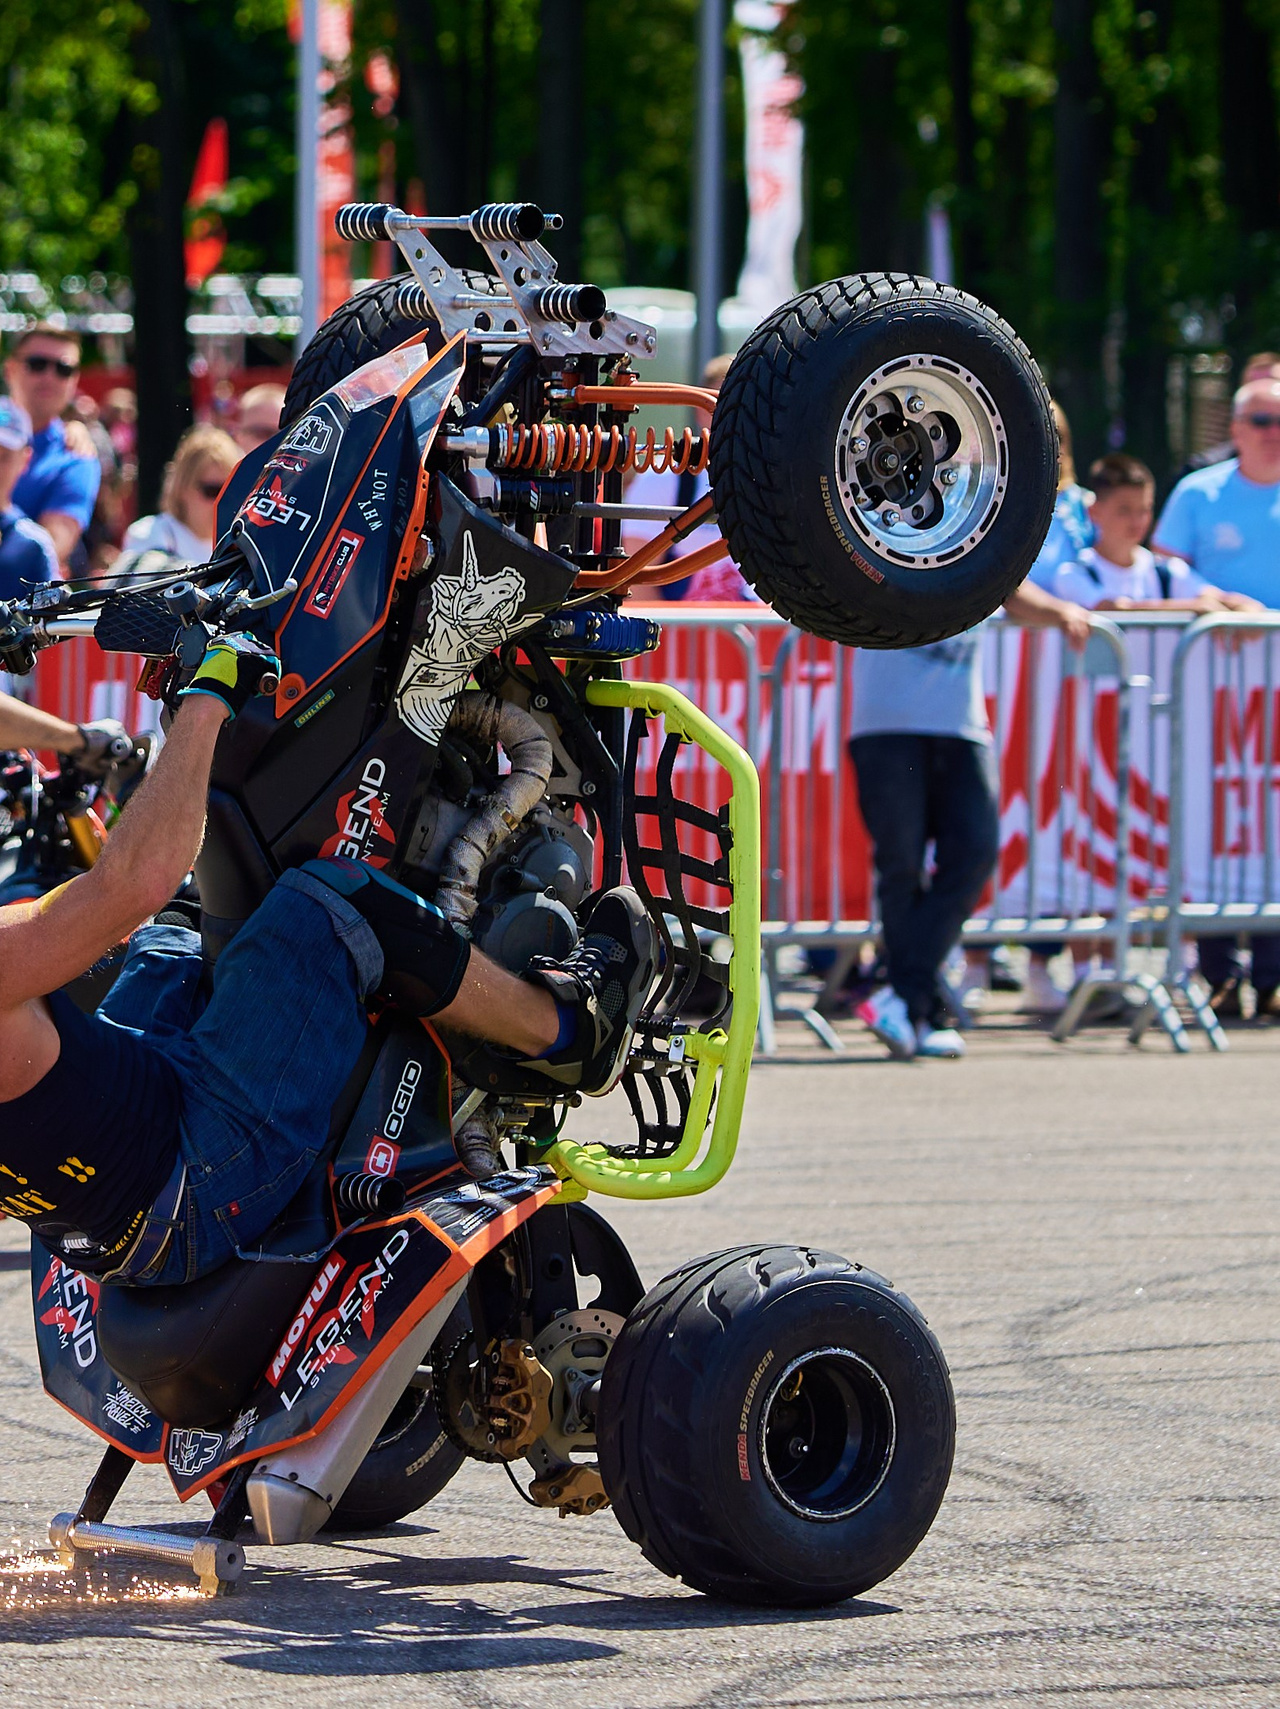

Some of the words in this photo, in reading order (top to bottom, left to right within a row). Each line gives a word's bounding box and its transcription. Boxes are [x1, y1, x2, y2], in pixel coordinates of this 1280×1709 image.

[358, 499, 384, 532] WHY
[372, 469, 388, 501] NOT
[820, 475, 853, 553] SPEEDRACER
[849, 551, 885, 584] KENDA
[369, 792, 391, 837] TEAM
[384, 1060, 422, 1140] OGIO
[50, 1254, 61, 1294] UNT
[54, 1296, 69, 1349] TEAM
[272, 1262, 341, 1379] MOTUL
[280, 1229, 410, 1411] LEGEND
[310, 1325, 352, 1389] STUNT
[353, 1272, 394, 1322] TEAM
[739, 1349, 775, 1433] SPEEDRACER
[737, 1434, 751, 1481] KENDA
